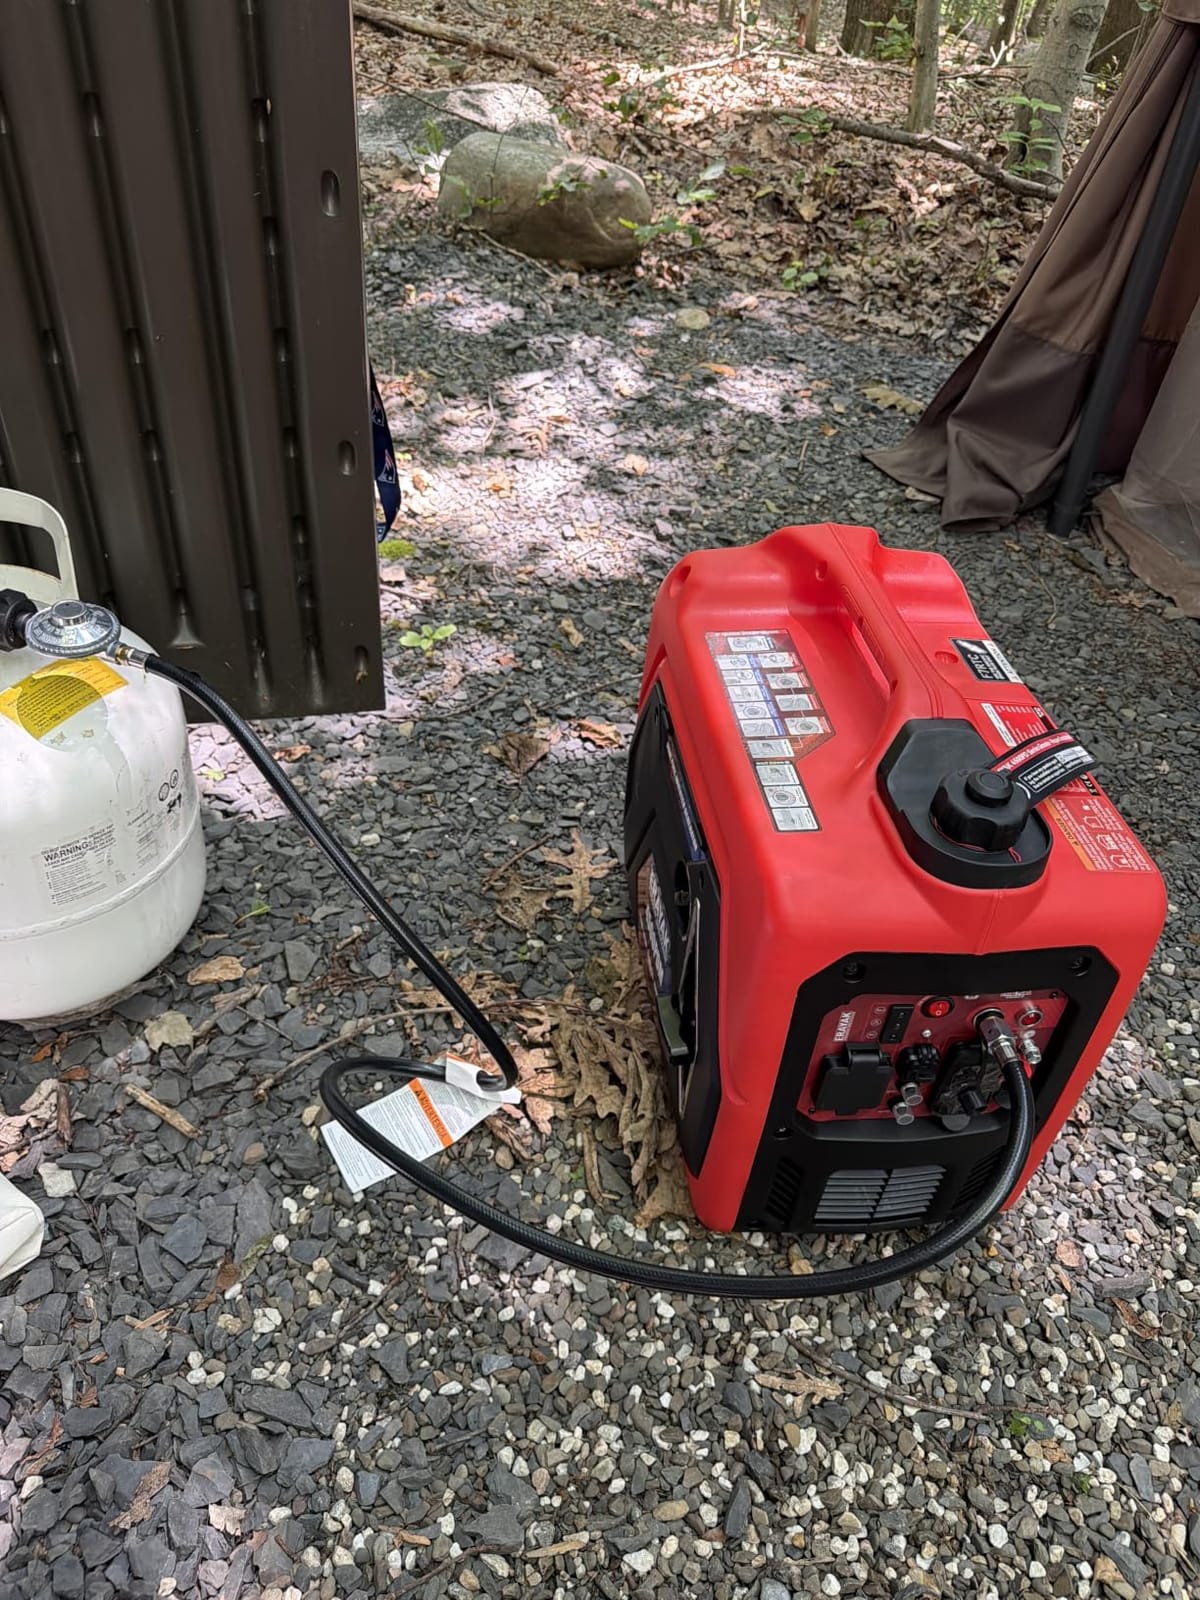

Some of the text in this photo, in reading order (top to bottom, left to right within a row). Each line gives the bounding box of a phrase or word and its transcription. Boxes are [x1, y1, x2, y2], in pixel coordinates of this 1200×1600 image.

[1056, 818, 1074, 840] DANGER
[43, 841, 89, 862] WARNING
[833, 1011, 851, 1041] ERAYAK
